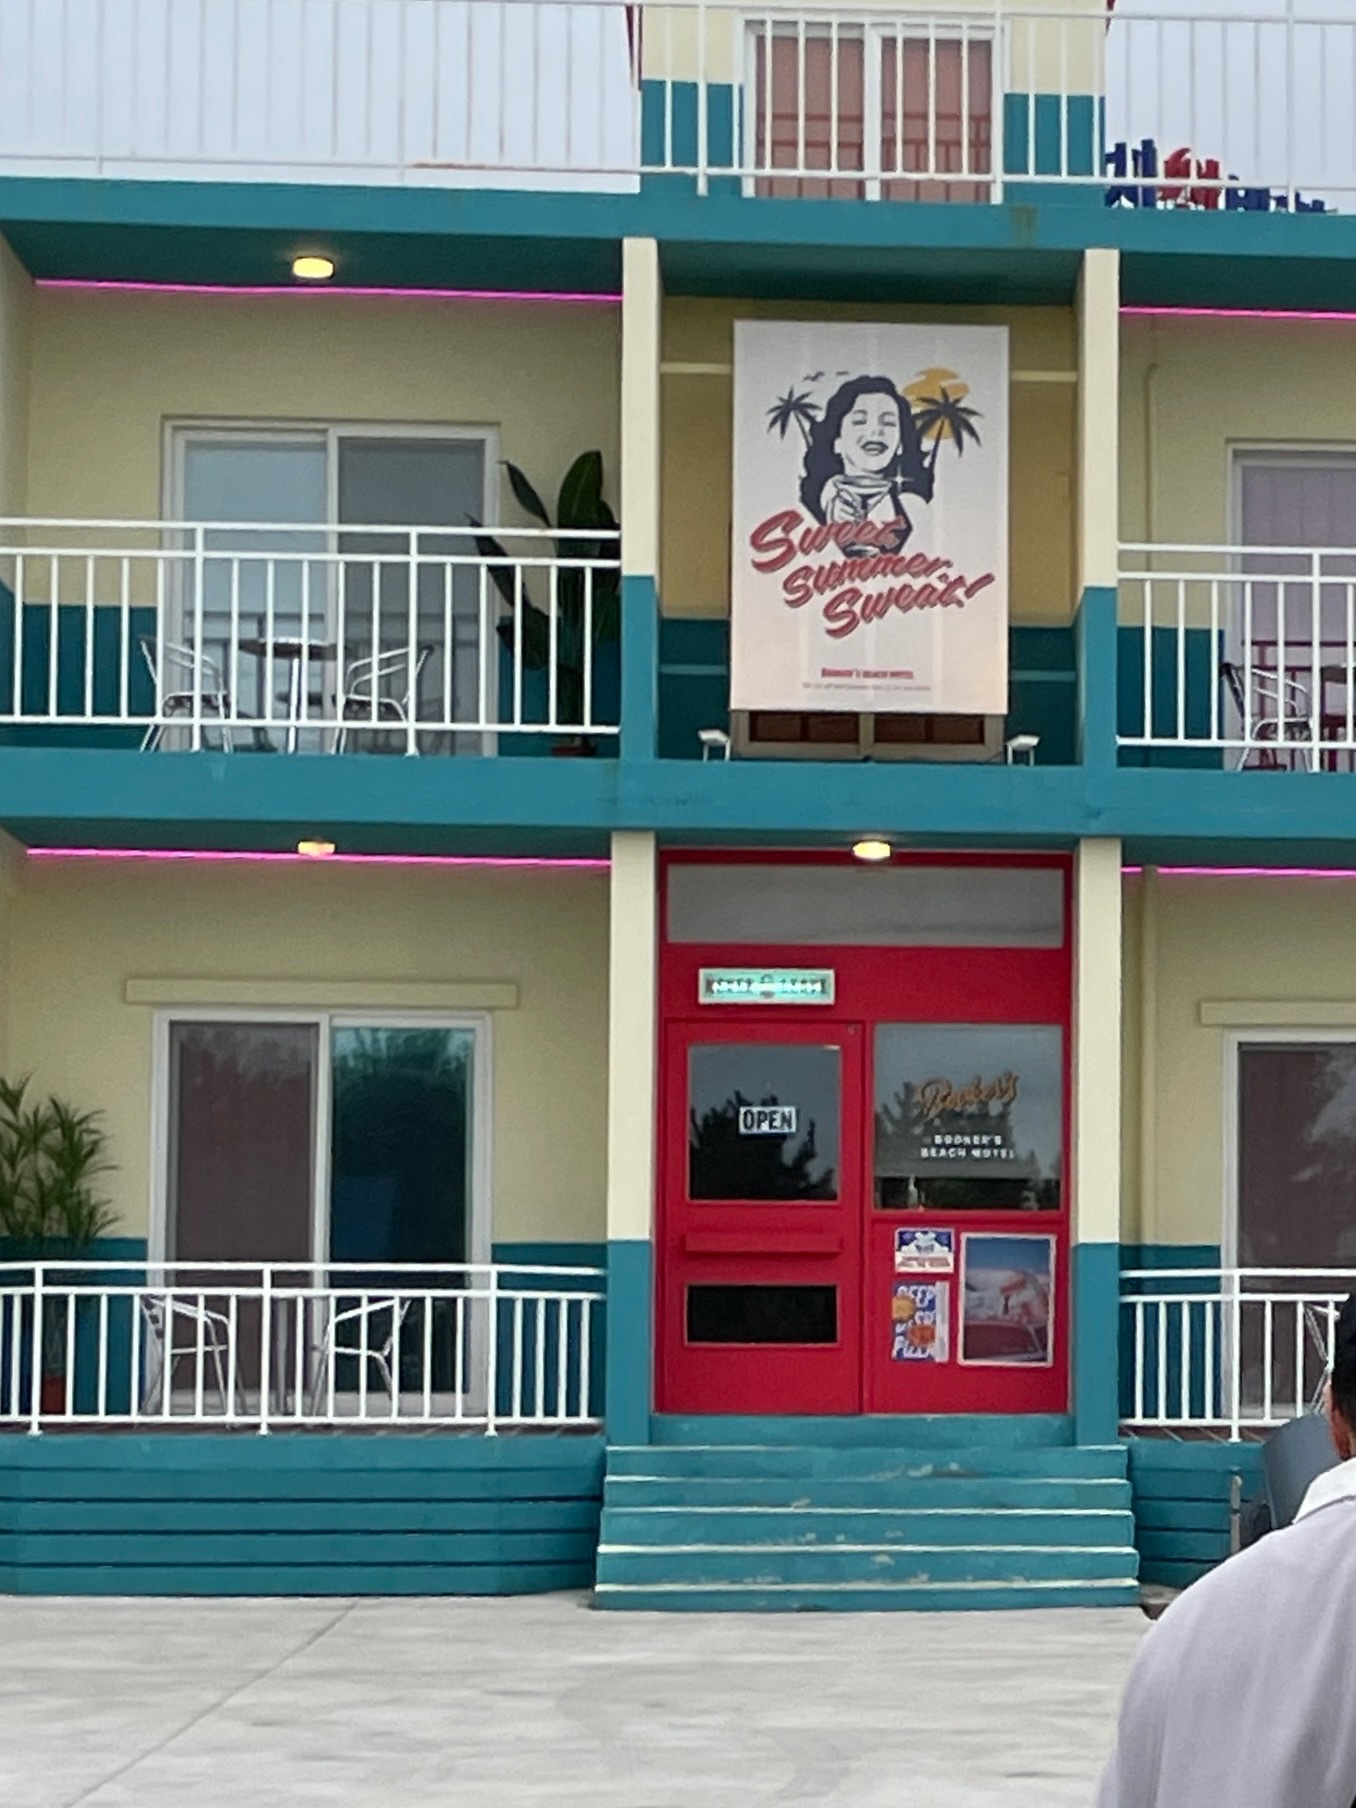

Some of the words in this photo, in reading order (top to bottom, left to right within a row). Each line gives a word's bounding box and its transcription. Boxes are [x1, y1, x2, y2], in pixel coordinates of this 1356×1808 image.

[750, 509, 907, 574] Sweet
[743, 1109, 793, 1130] OPEN
[920, 1147, 967, 1158] BEACH
